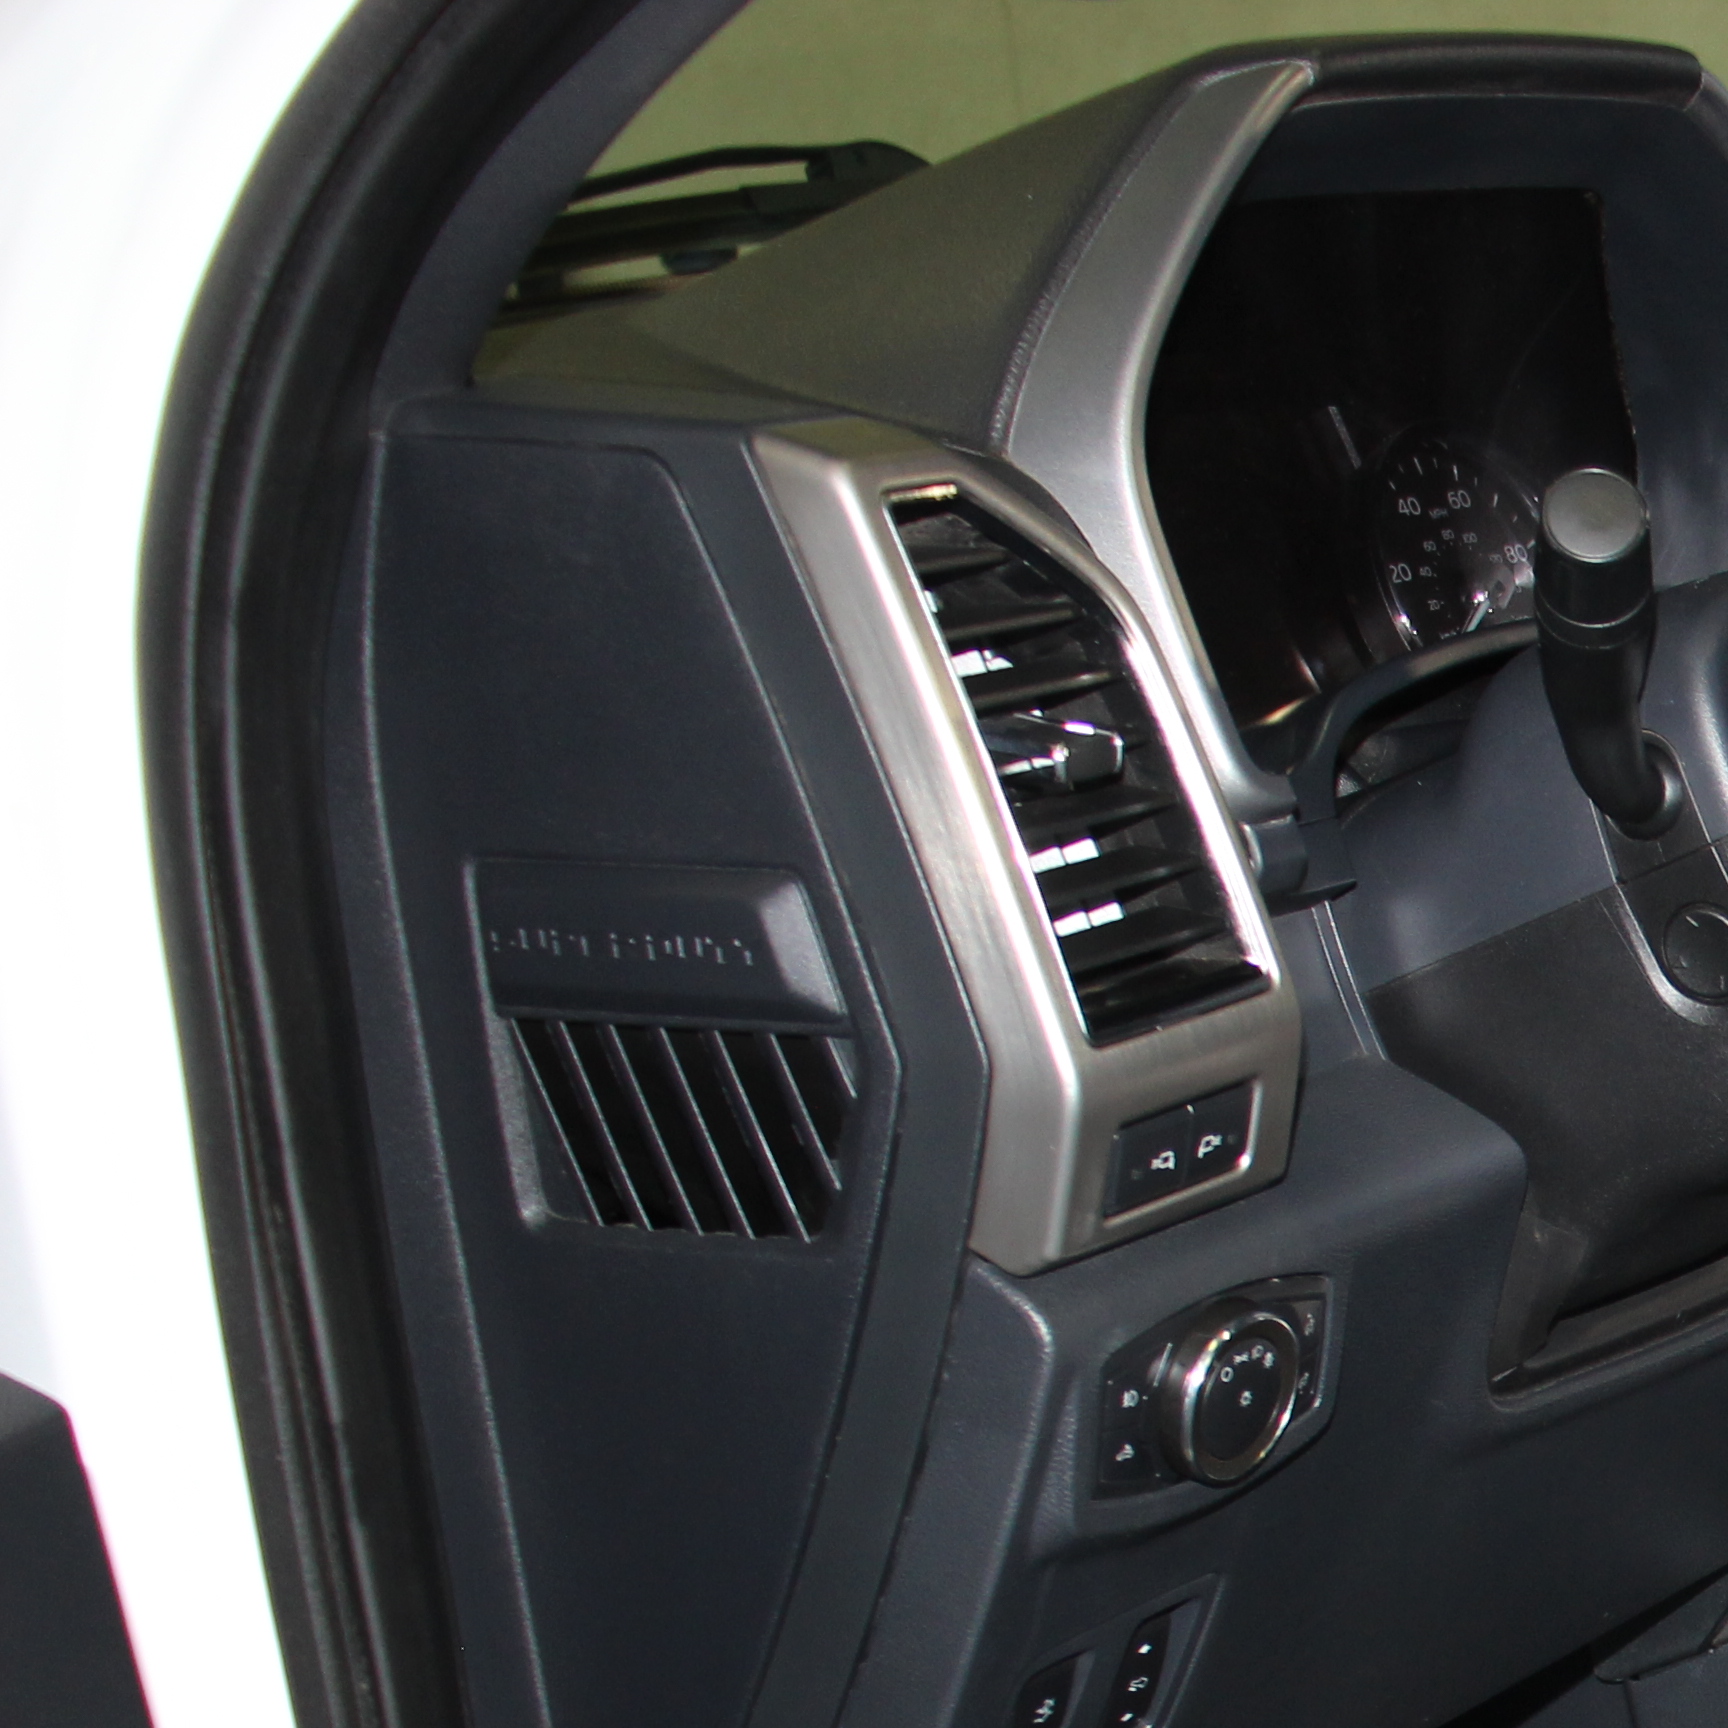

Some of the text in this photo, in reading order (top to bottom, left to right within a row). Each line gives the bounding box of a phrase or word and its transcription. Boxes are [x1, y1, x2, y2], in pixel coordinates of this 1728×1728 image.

[1398, 496, 1421, 516] 40
[1447, 489, 1472, 509] 60
[1504, 543, 1528, 564] 80
[1389, 563, 1412, 583] 20
